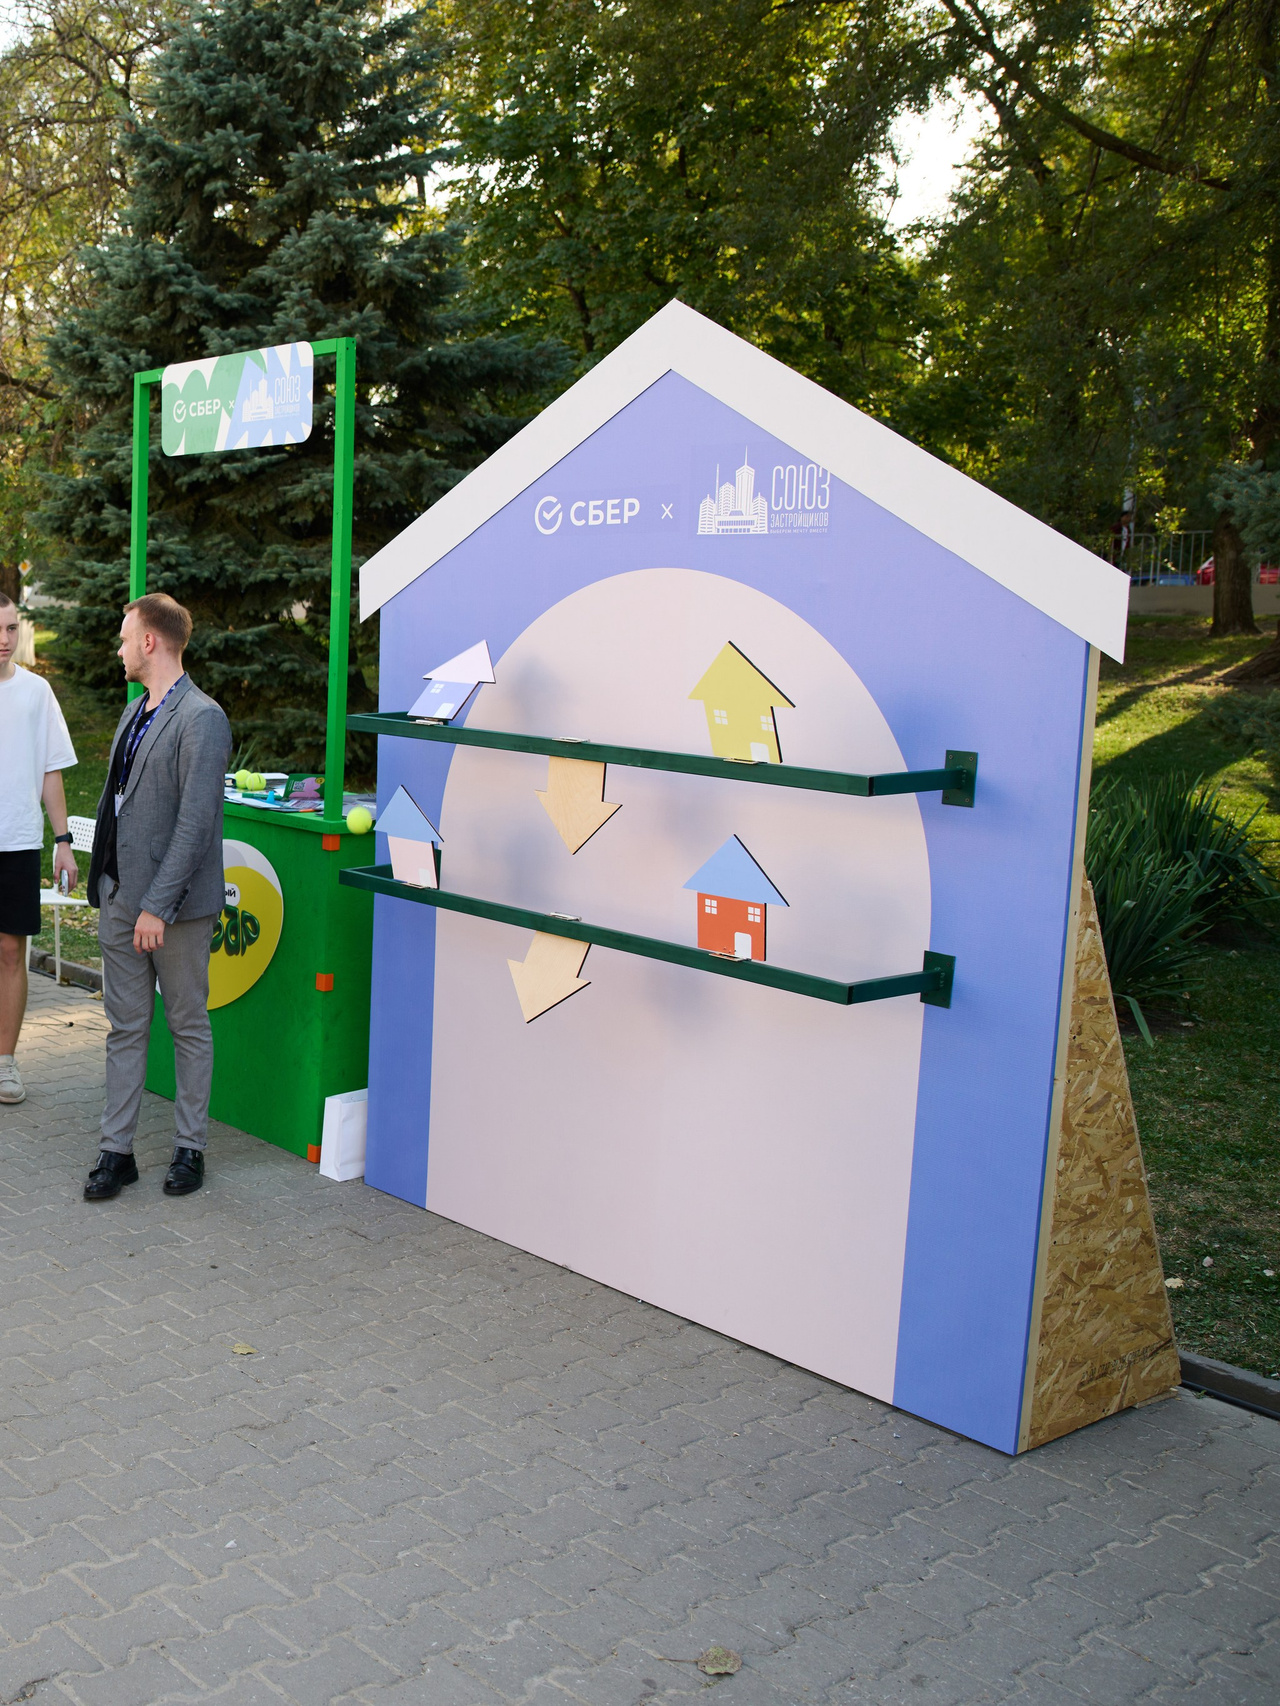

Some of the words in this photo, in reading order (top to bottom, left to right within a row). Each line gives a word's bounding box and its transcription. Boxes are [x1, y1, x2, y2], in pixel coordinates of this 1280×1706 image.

[275, 375, 300, 404] СОЮЗ
[189, 398, 221, 417] СБЕР
[771, 464, 831, 511] СОЮЗ
[570, 498, 640, 526] СБЕР
[770, 511, 829, 528] ЗАСТРОЙЩИКОВ
